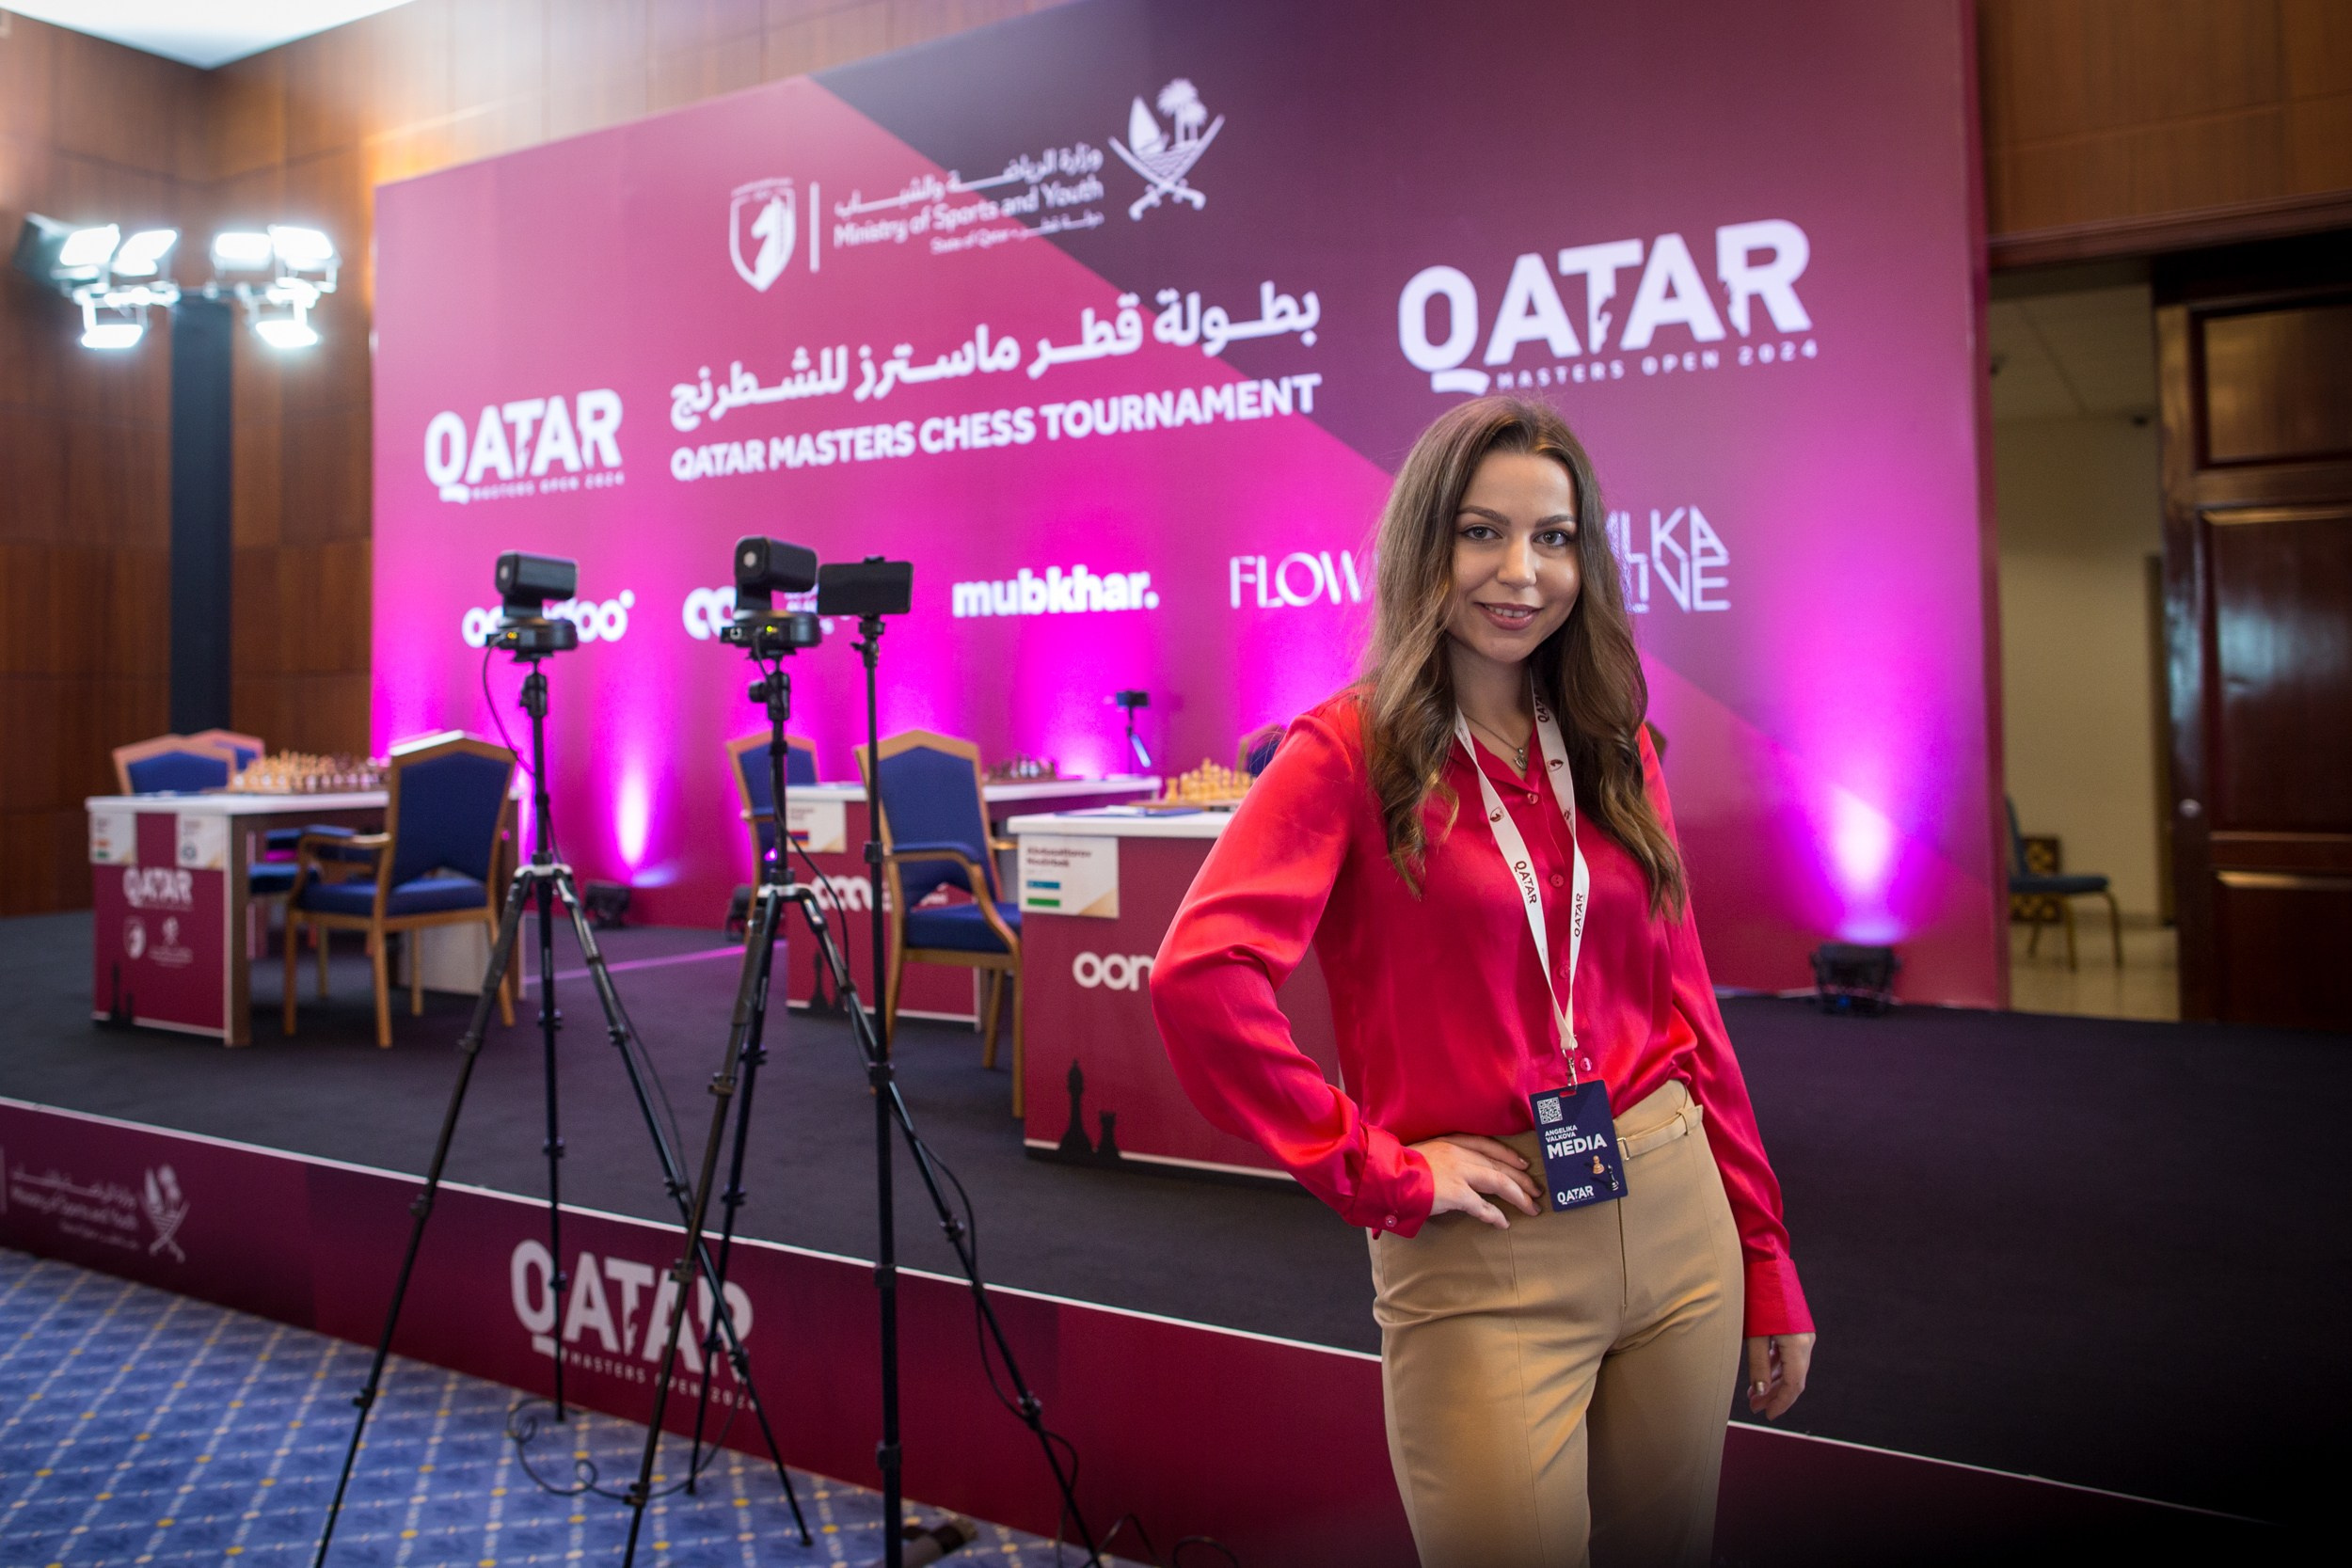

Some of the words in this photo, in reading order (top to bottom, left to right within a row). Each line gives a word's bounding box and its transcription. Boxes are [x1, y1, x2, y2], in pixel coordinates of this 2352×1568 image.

[834, 219, 909, 248] Ministry
[909, 204, 932, 235] of
[932, 198, 1001, 233] Sports
[1001, 184, 1040, 218] and
[1040, 173, 1104, 208] Youth
[1026, 292, 1143, 380] قطر
[1152, 280, 1321, 357] بطولة
[1398, 217, 1814, 396] QATAR
[670, 344, 849, 432] للشطرنج
[853, 324, 1021, 403] ماسترز
[1497, 358, 1625, 390] MASTERS
[1642, 349, 1720, 376] OPEN
[1738, 339, 1819, 367] 2024
[423, 388, 624, 504] QATAR
[670, 438, 767, 482] QATAR
[769, 420, 916, 469] MASTERS
[919, 405, 1036, 453] CHESS
[1039, 372, 1323, 440] TOURNAMENT
[952, 564, 1161, 618] mubkhar.
[1229, 549, 1372, 610] FLOW
[1514, 860, 1537, 905] QATAR
[1574, 893, 1583, 938] QATAR
[1545, 1125, 1578, 1137] ANGELIKA
[1546, 1132, 1576, 1143] VALKOVA
[1547, 1133, 1607, 1160] MEDIA
[1557, 1185, 1595, 1205] QATAR
[510, 1239, 754, 1385] QATAR
[569, 1352, 646, 1384] MASTERS
